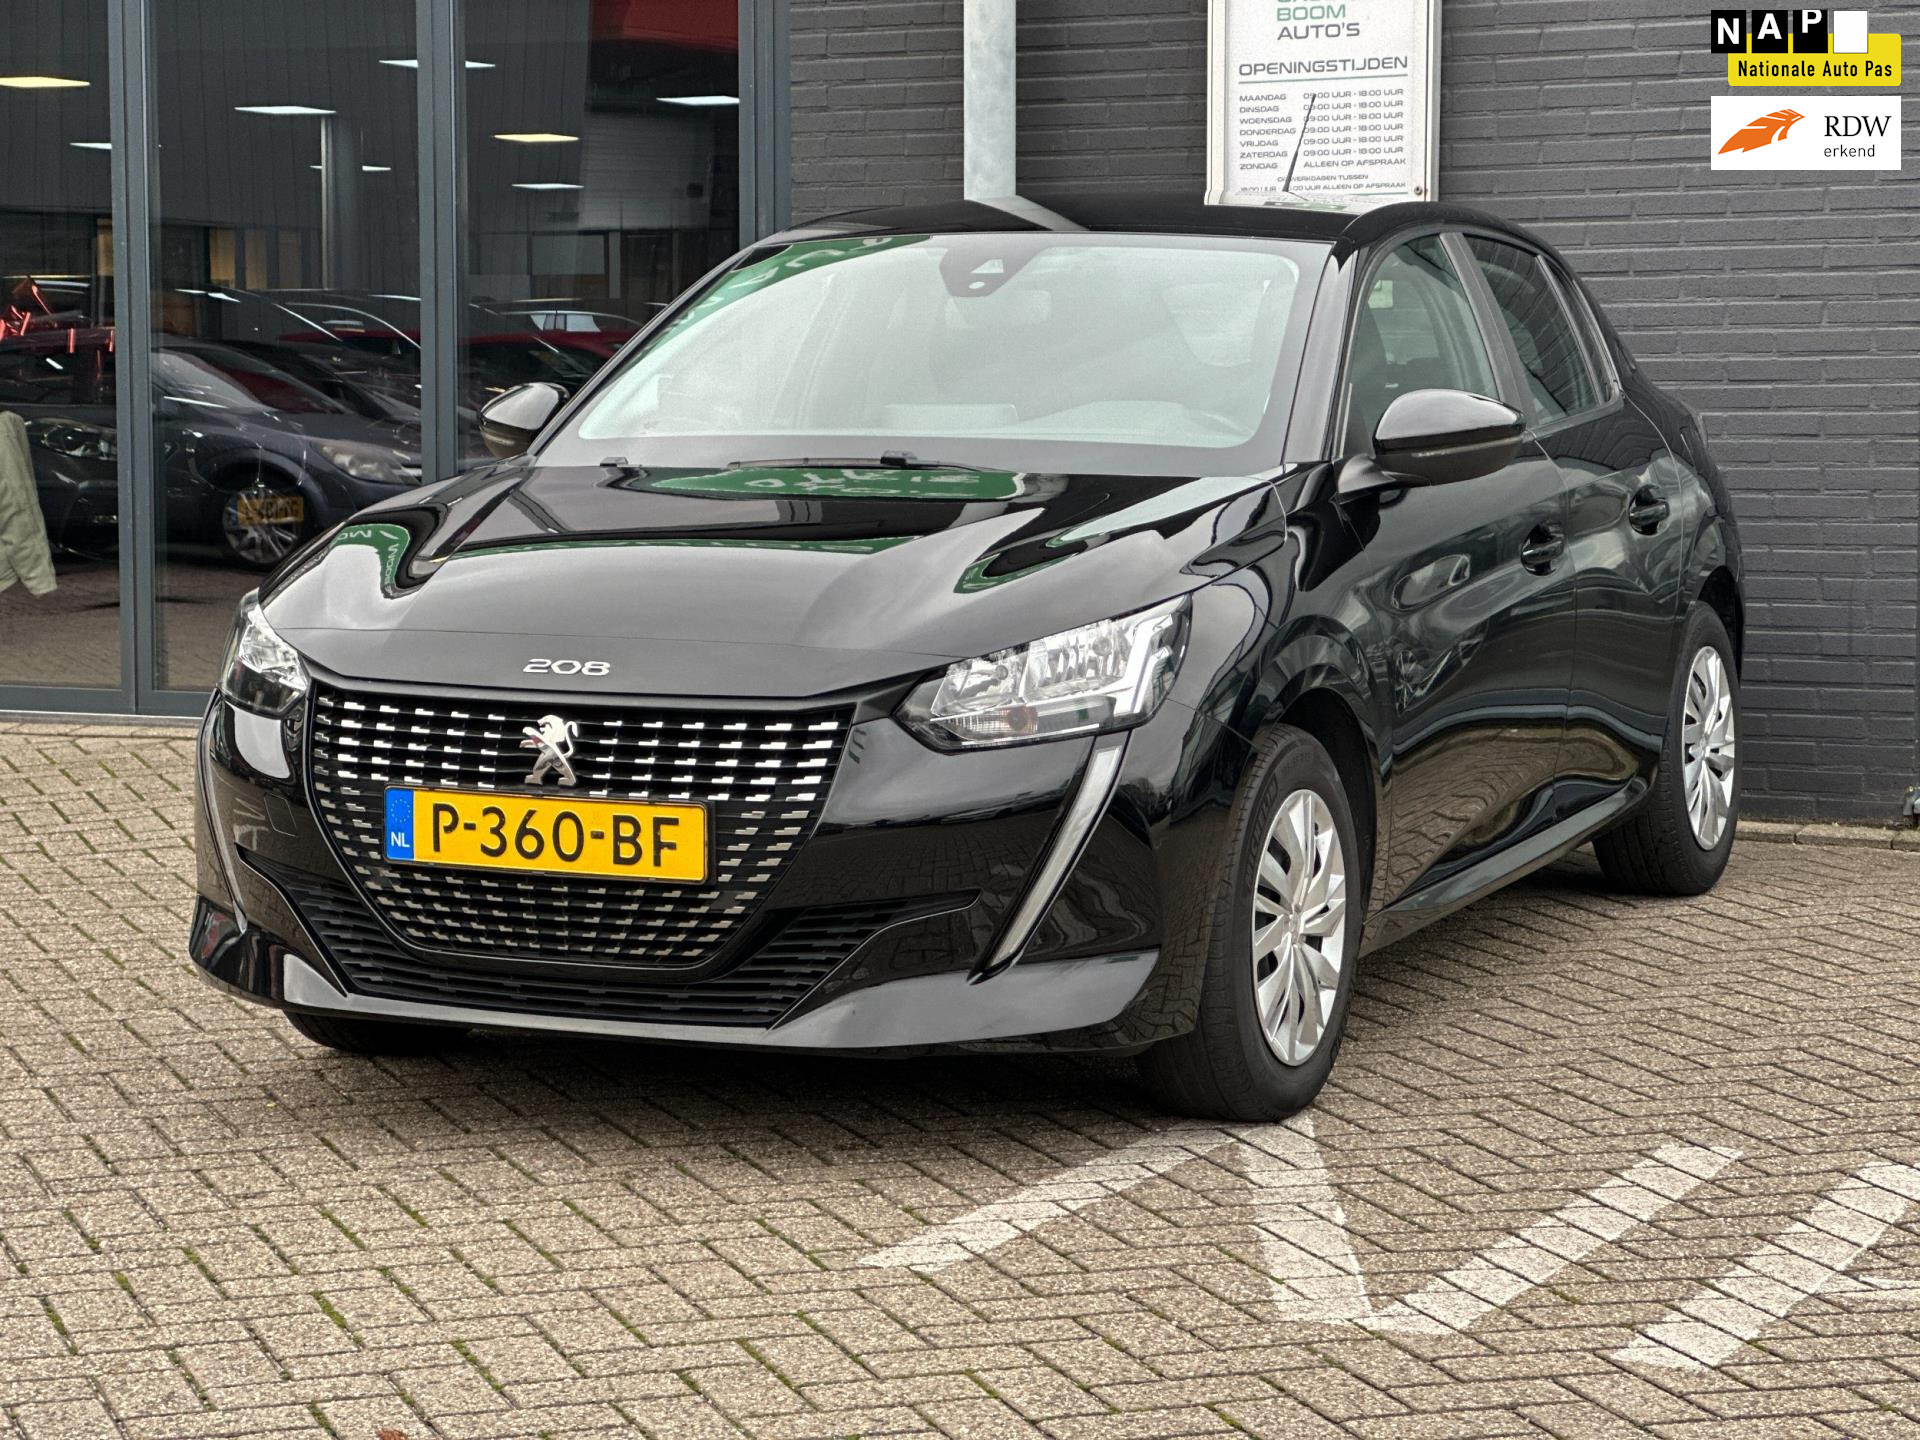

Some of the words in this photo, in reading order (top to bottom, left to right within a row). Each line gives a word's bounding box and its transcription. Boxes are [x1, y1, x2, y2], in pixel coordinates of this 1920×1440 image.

[1277, 4, 1346, 22] BOOM
[1277, 22, 1360, 41] AUTO'S
[1238, 56, 1408, 76] OPENINGSTIJDEN
[1239, 94, 1287, 102] MAANDAG
[1239, 106, 1280, 114] DINSDAG
[1239, 116, 1292, 125] WOENSDAG
[1239, 128, 1296, 136] DONDERDAG
[1239, 139, 1279, 148] VRIJDAG
[1239, 150, 1288, 159] ZATERDAG
[1239, 162, 1278, 170] ZONDAG
[1304, 160, 1339, 168] ALLEEN
[1356, 158, 1406, 166] AFSPRAAK
[522, 658, 611, 676] 208
[390, 831, 410, 848] NL
[432, 802, 680, 867] P-360-BF
